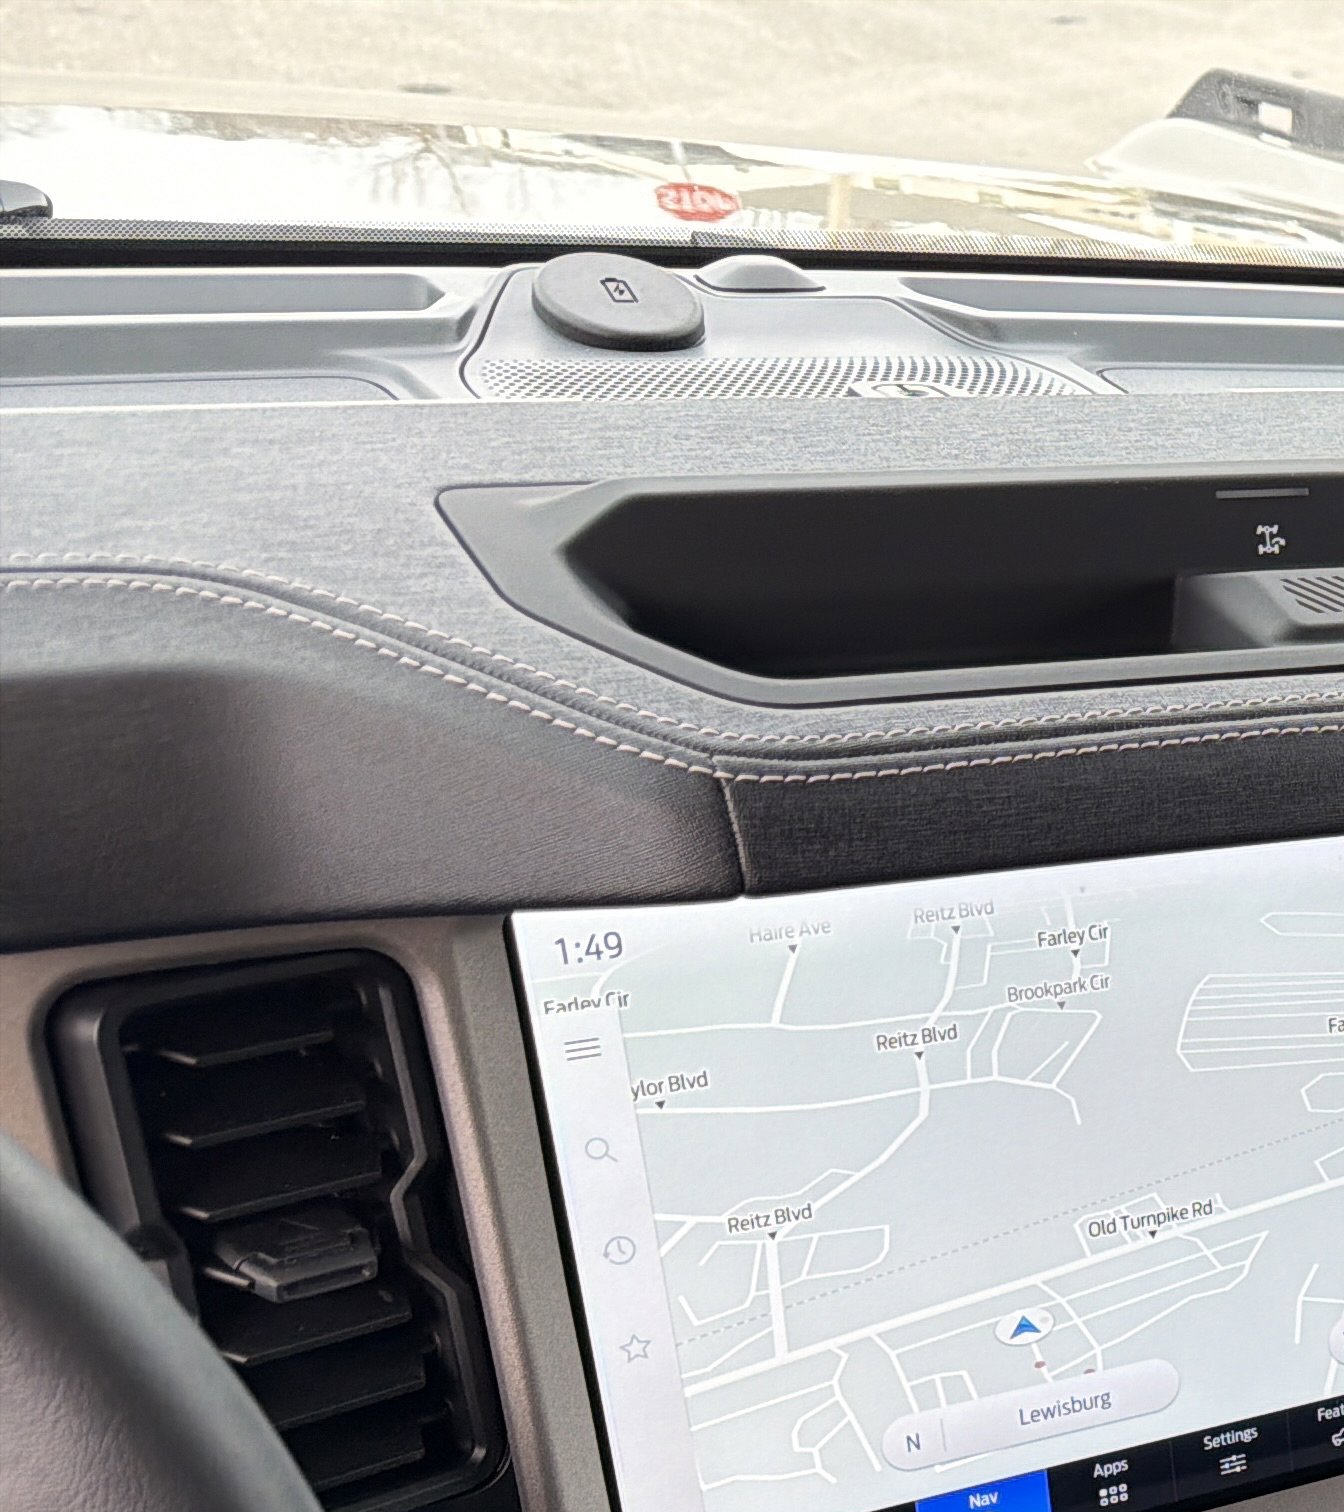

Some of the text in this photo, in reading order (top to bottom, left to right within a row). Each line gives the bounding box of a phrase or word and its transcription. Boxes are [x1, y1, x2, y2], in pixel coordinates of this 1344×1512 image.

[913, 900, 996, 925] Reitz Blvd
[799, 919, 831, 937] Ave
[1037, 923, 1110, 949] Farley Cir
[554, 931, 624, 966] 1:49
[1007, 973, 1111, 1004] Brookpark Cir
[876, 1023, 959, 1052] Reitz Blvd
[668, 1071, 709, 1093] Blvd
[727, 1203, 814, 1234] Reitz Blvd
[1088, 1199, 1214, 1240] Old Turnpike Rd
[1018, 1389, 1112, 1427] Lewisburg
[906, 1432, 921, 1452] N
[1203, 1424, 1258, 1453] Settings
[1093, 1458, 1129, 1480] Apps
[968, 1490, 999, 1509] Nav
